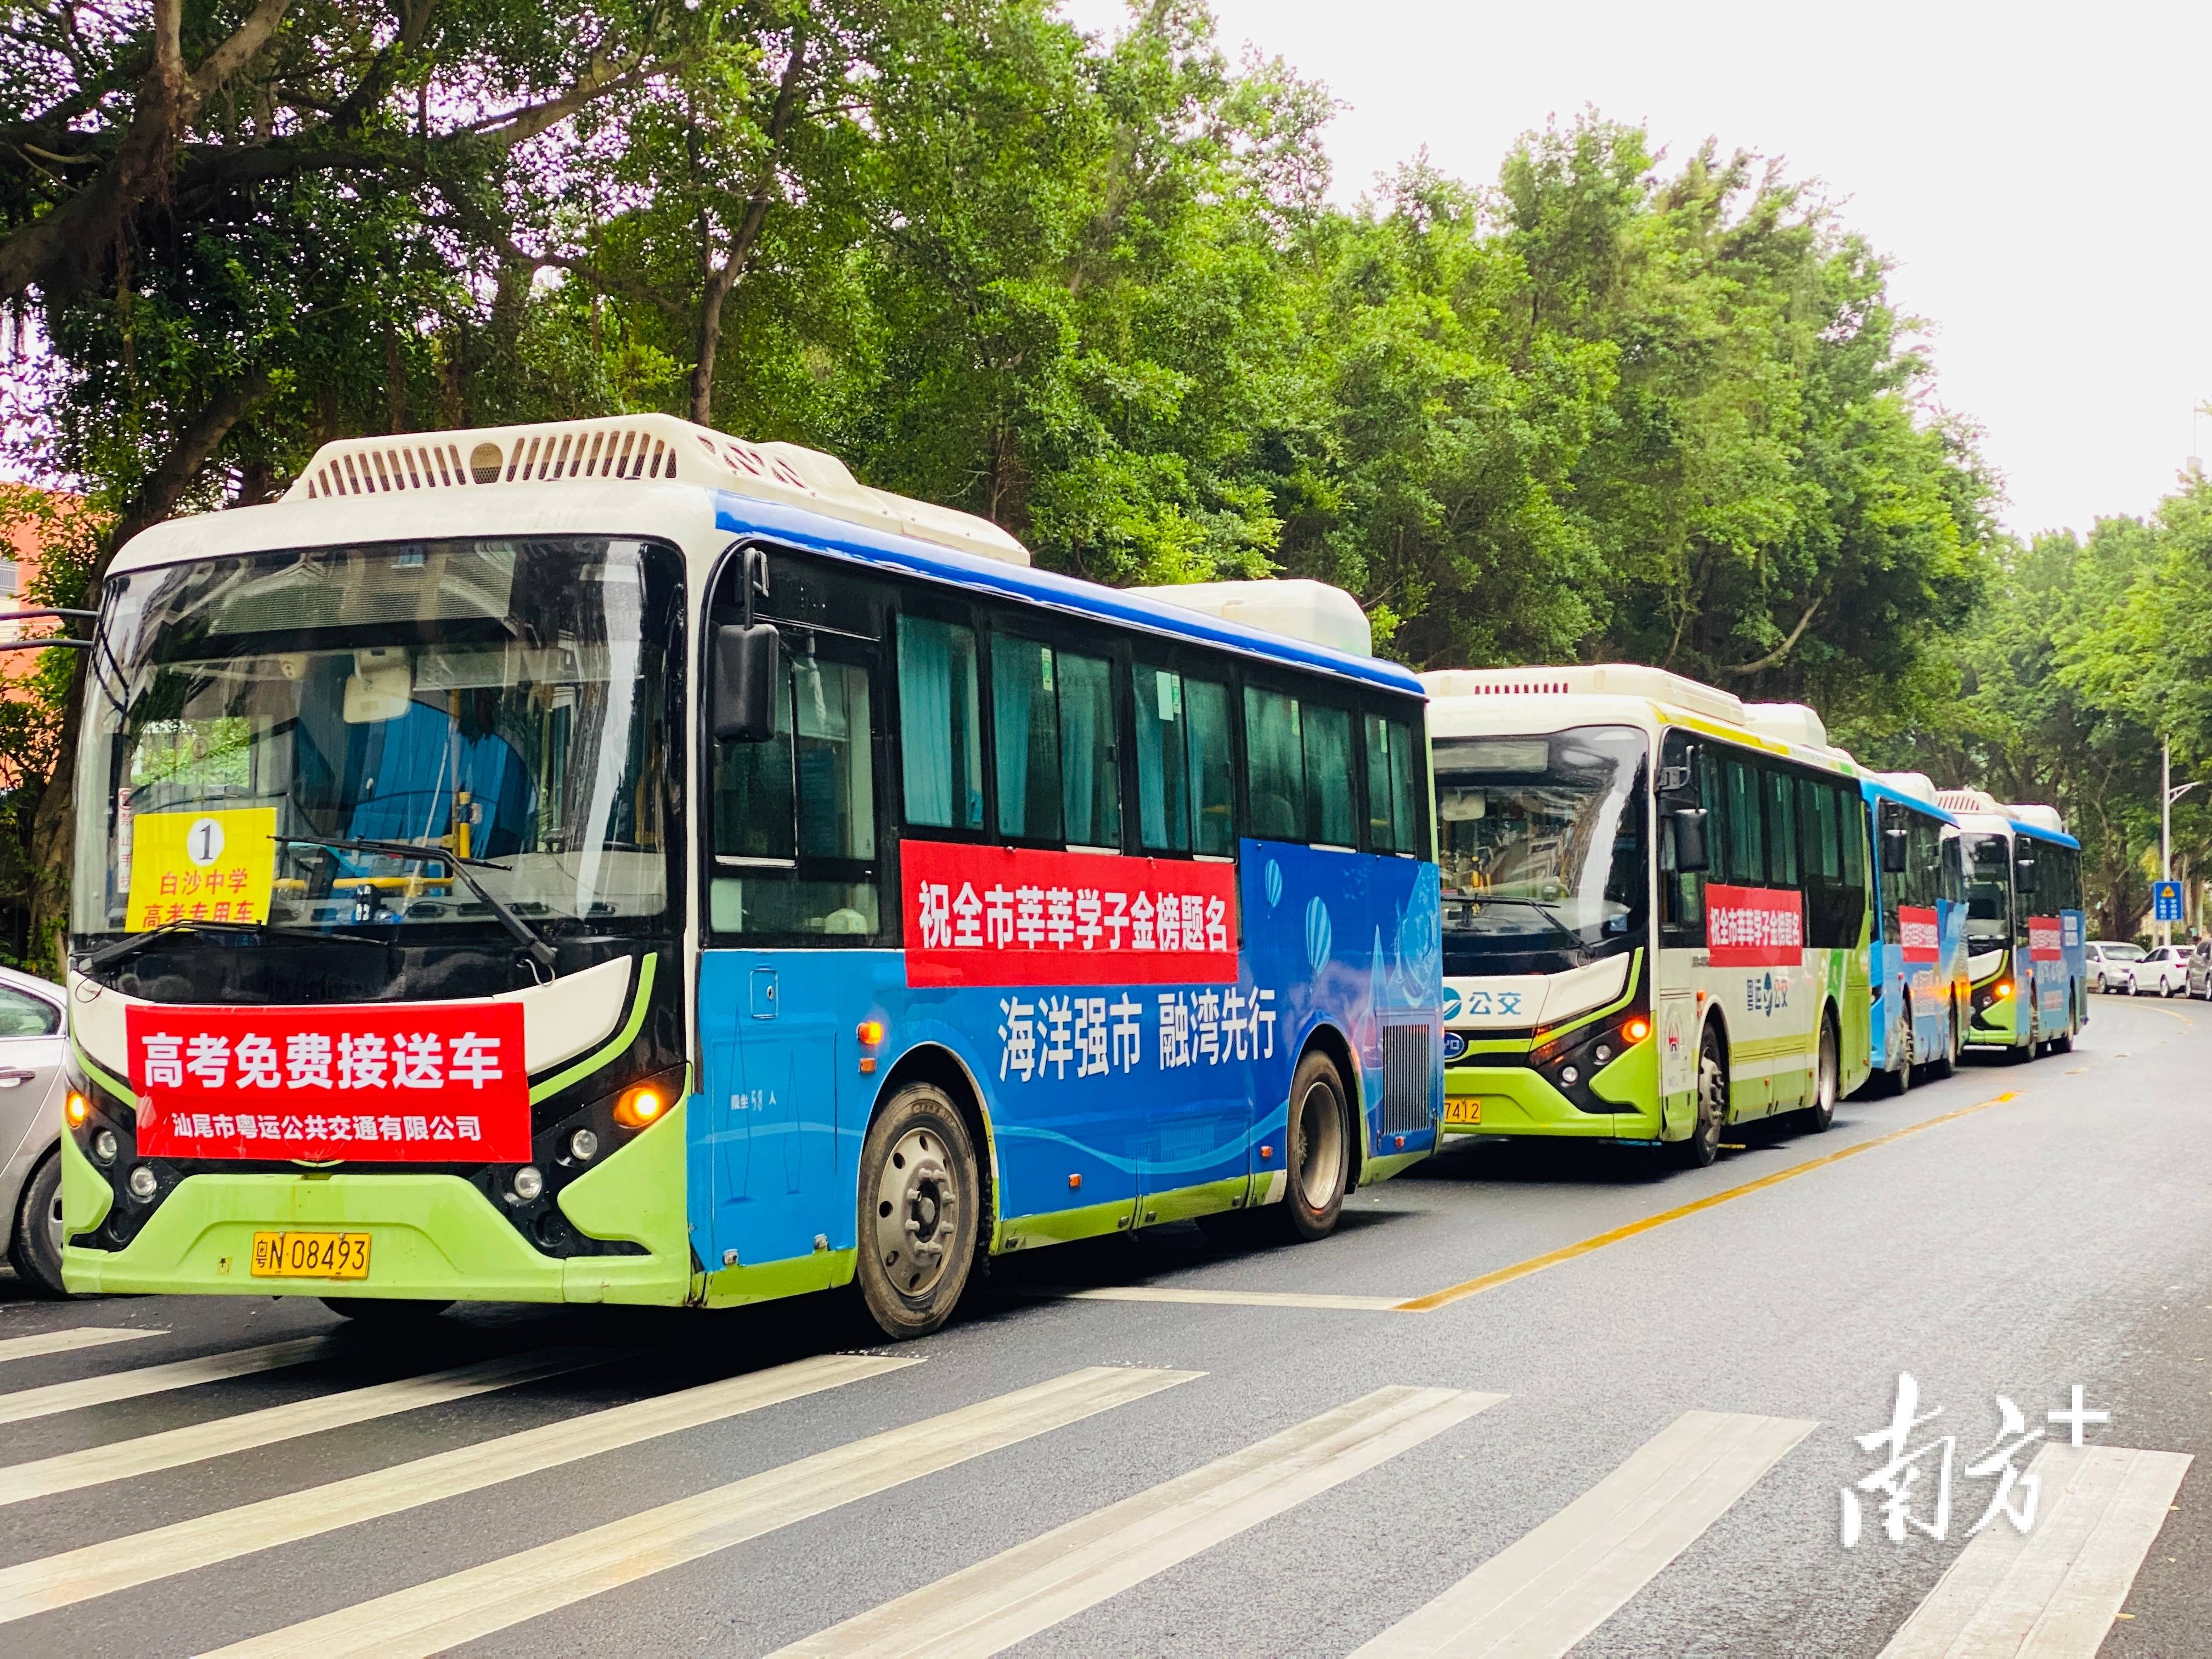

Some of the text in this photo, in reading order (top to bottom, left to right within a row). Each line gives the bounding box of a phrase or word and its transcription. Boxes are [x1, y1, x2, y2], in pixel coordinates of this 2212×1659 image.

[199, 824, 213, 860] 1
[159, 867, 249, 896] 白沙中学
[142, 899, 255, 929] 高考专用车
[918, 879, 1228, 951] 祝全市莘莘学子金榜题名
[1469, 991, 1521, 1015] 公交
[998, 985, 1276, 1082] 海洋强市 融湾先行
[141, 1032, 503, 1090] 高考免费接送车
[1445, 1102, 1479, 1120] 7412
[171, 1112, 482, 1142] 汕尾市粤运公共交通有限公司
